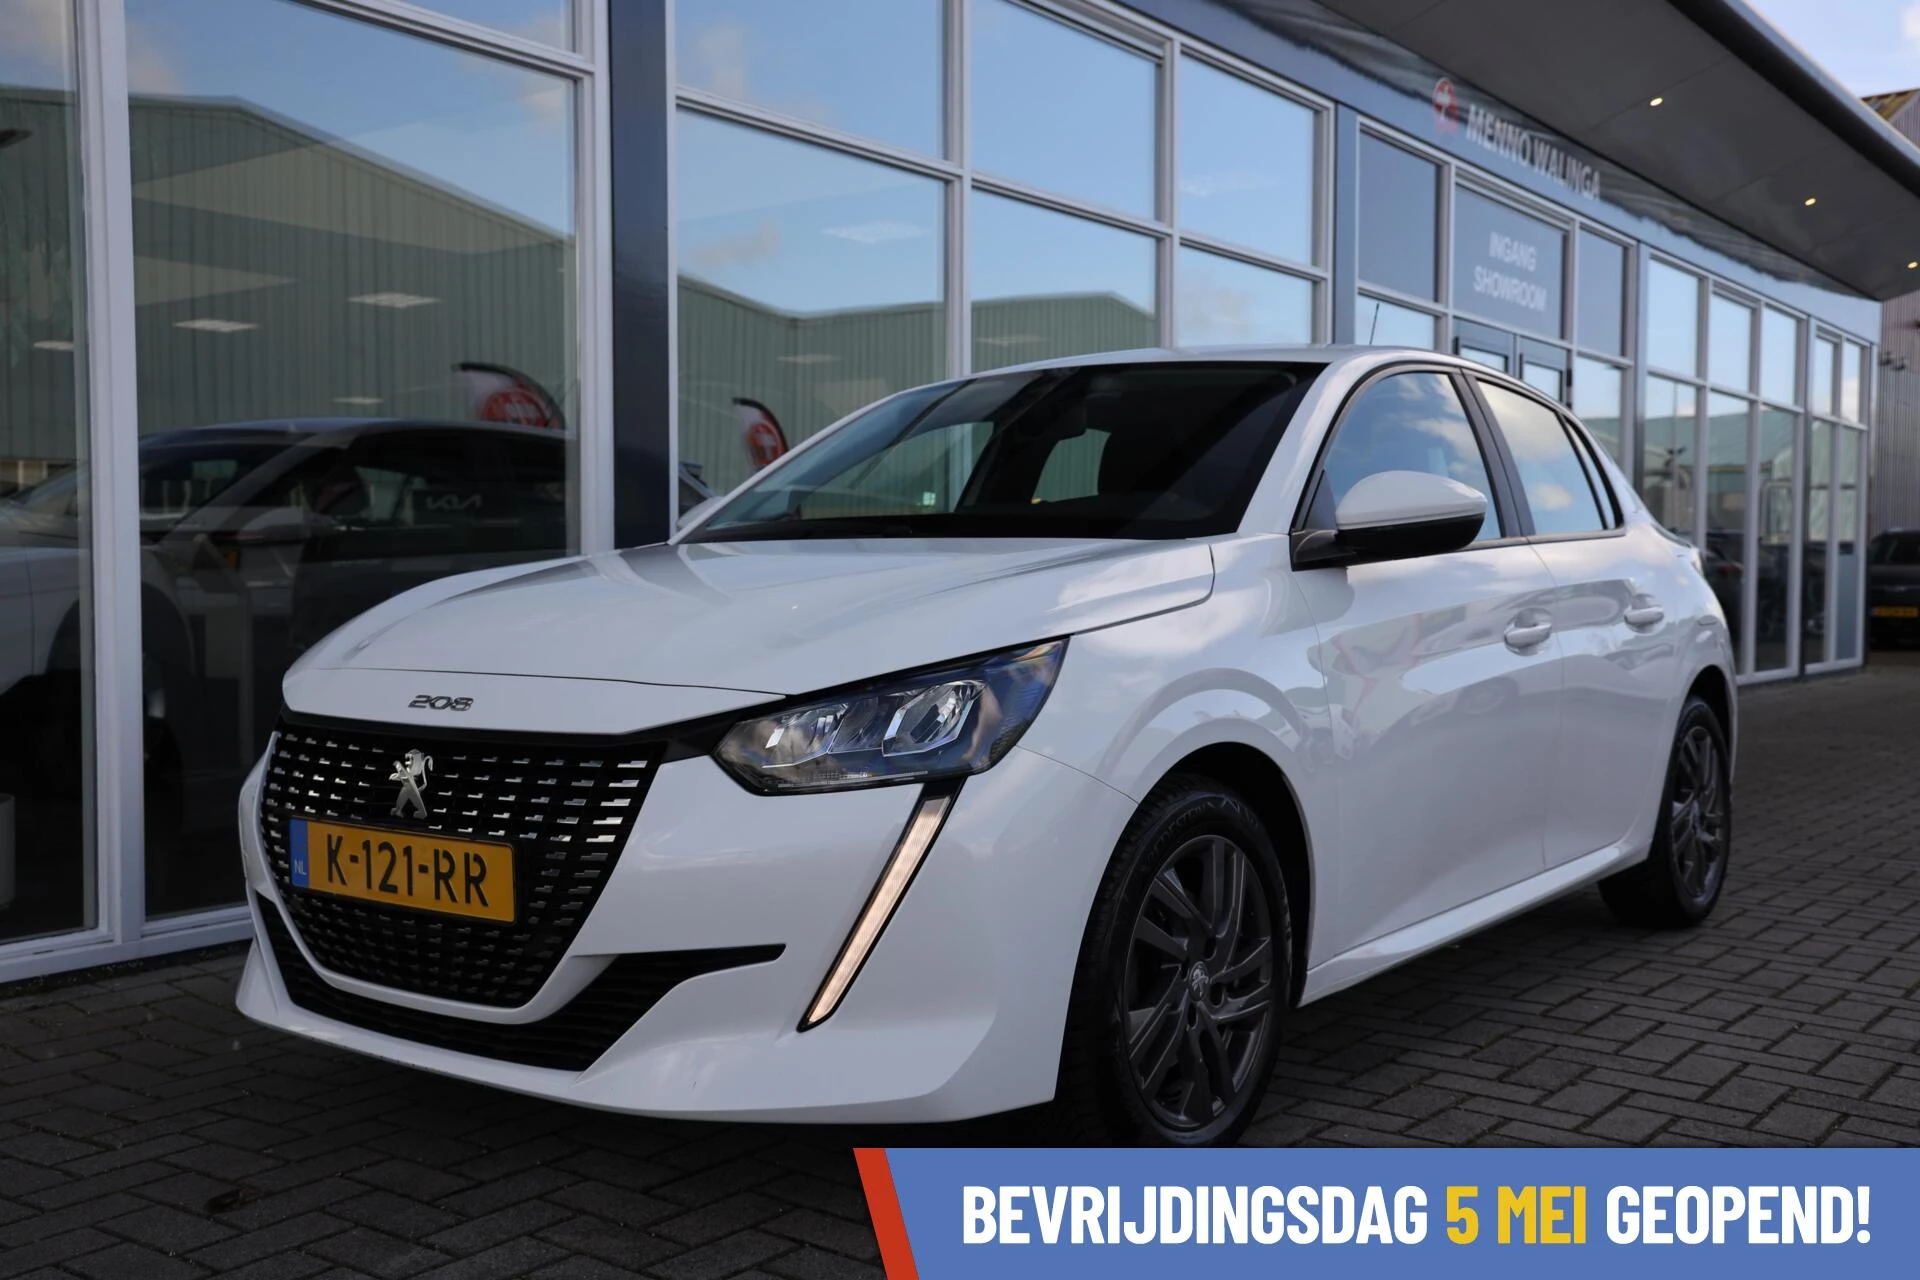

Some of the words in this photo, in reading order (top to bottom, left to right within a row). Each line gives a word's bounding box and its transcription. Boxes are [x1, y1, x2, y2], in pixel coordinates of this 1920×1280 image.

[1466, 104, 1532, 168] MENNO
[1535, 136, 1601, 200] WALINGA
[1489, 232, 1536, 272] INGANG
[1473, 265, 1547, 312] SHOWROOM
[408, 694, 474, 711] 208
[294, 860, 307, 875] NL
[326, 833, 489, 908] K-121-RR
